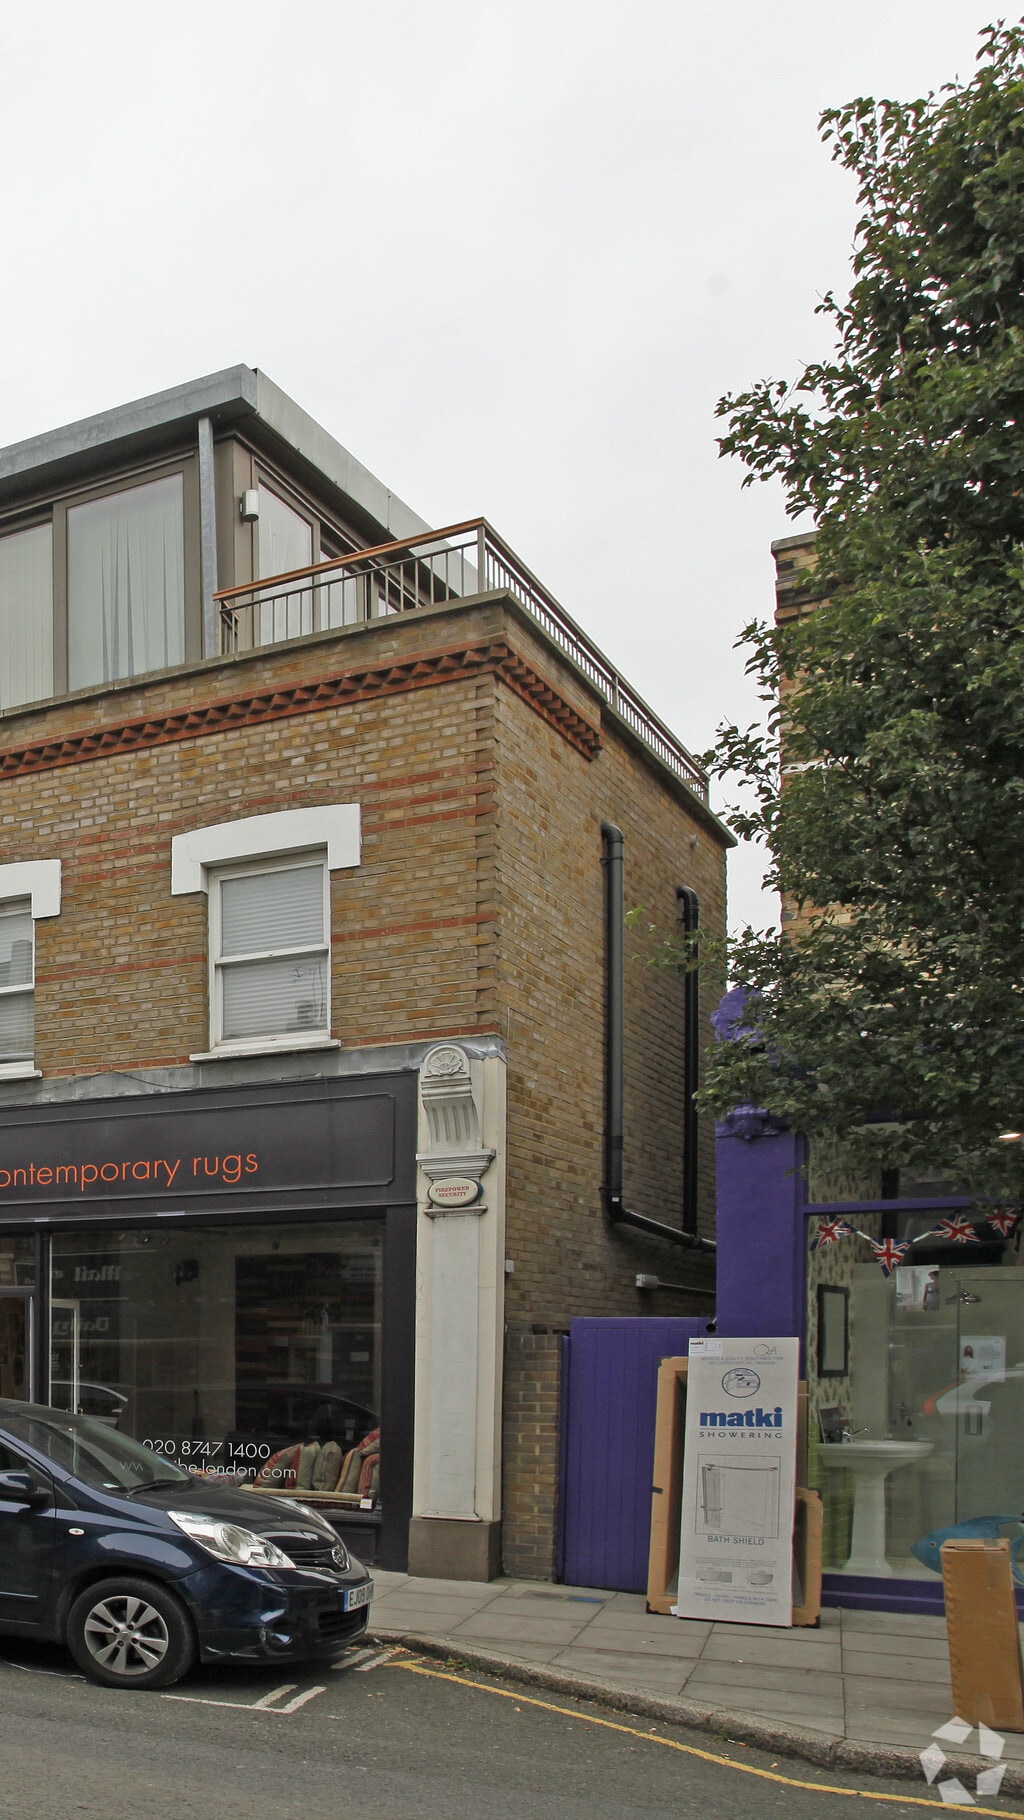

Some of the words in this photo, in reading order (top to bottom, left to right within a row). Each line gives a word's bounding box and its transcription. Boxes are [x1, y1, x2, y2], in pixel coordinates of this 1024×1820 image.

[193, 1153, 259, 1183] rugs
[699, 1407, 783, 1427] matki
[699, 1431, 783, 1439] SHOWERING
[181, 1440, 223, 1456] 8747
[228, 1442, 271, 1459] 1400
[707, 1535, 730, 1544] BATH
[733, 1536, 765, 1546] SHIELD
